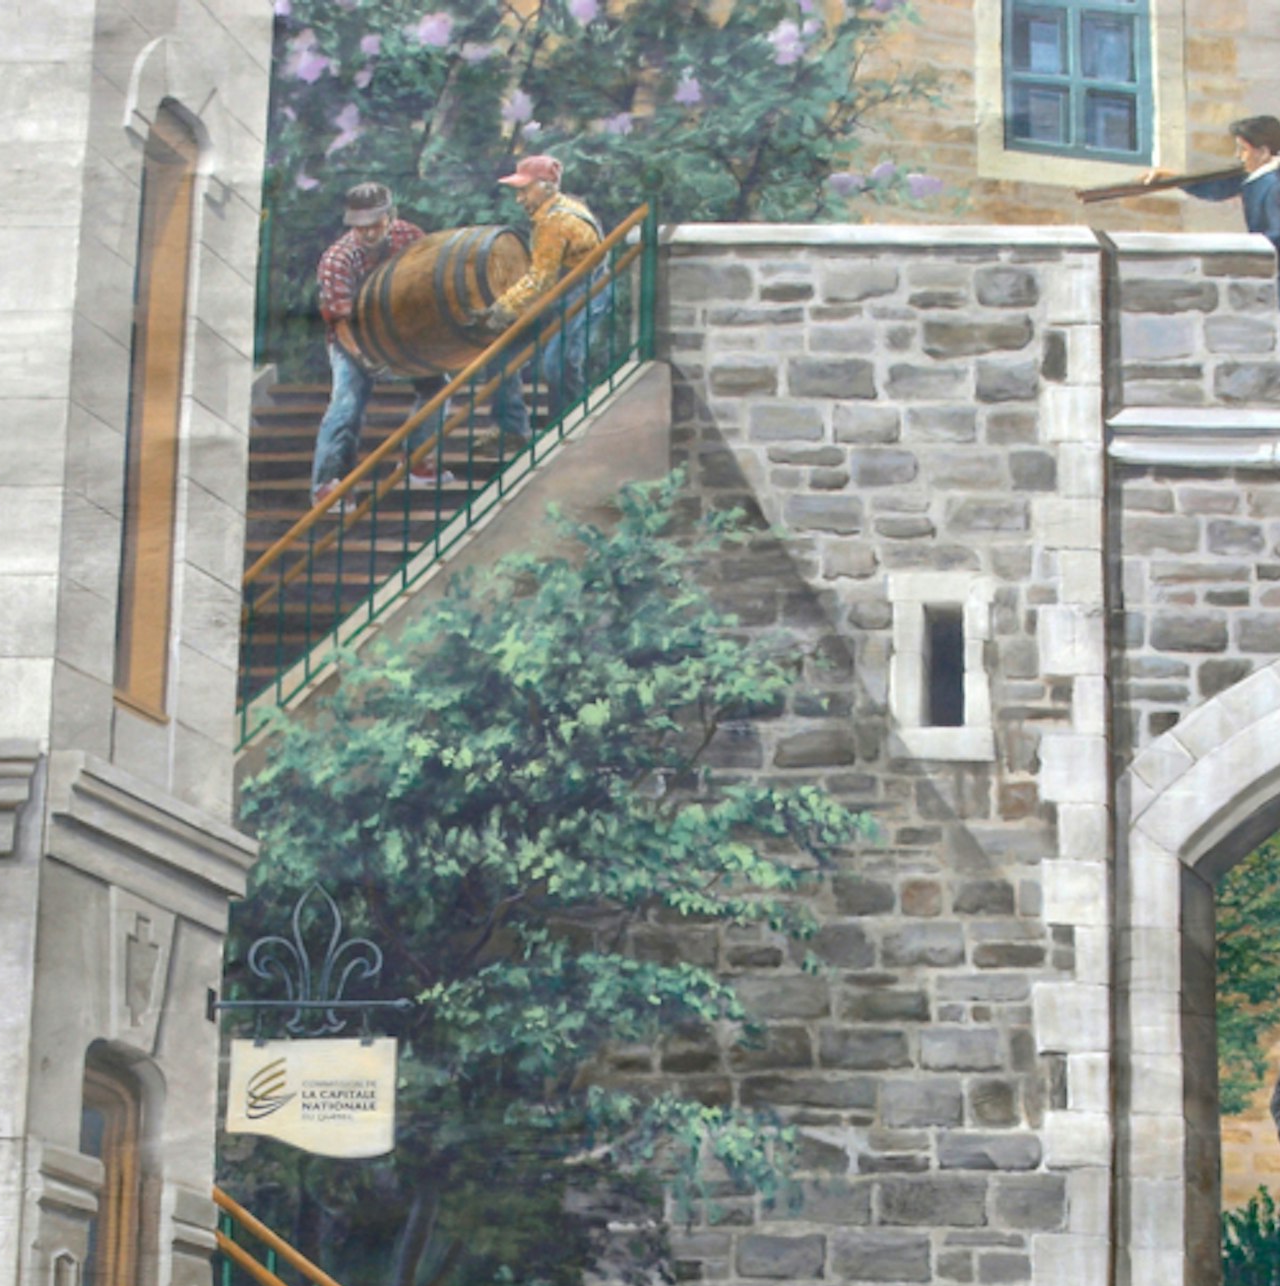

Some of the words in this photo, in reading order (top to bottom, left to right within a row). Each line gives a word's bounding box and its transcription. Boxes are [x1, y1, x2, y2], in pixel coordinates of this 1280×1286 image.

[302, 1090, 317, 1099] LA
[319, 1090, 376, 1099] CAPITALE
[302, 1102, 377, 1111] NATIONALE
